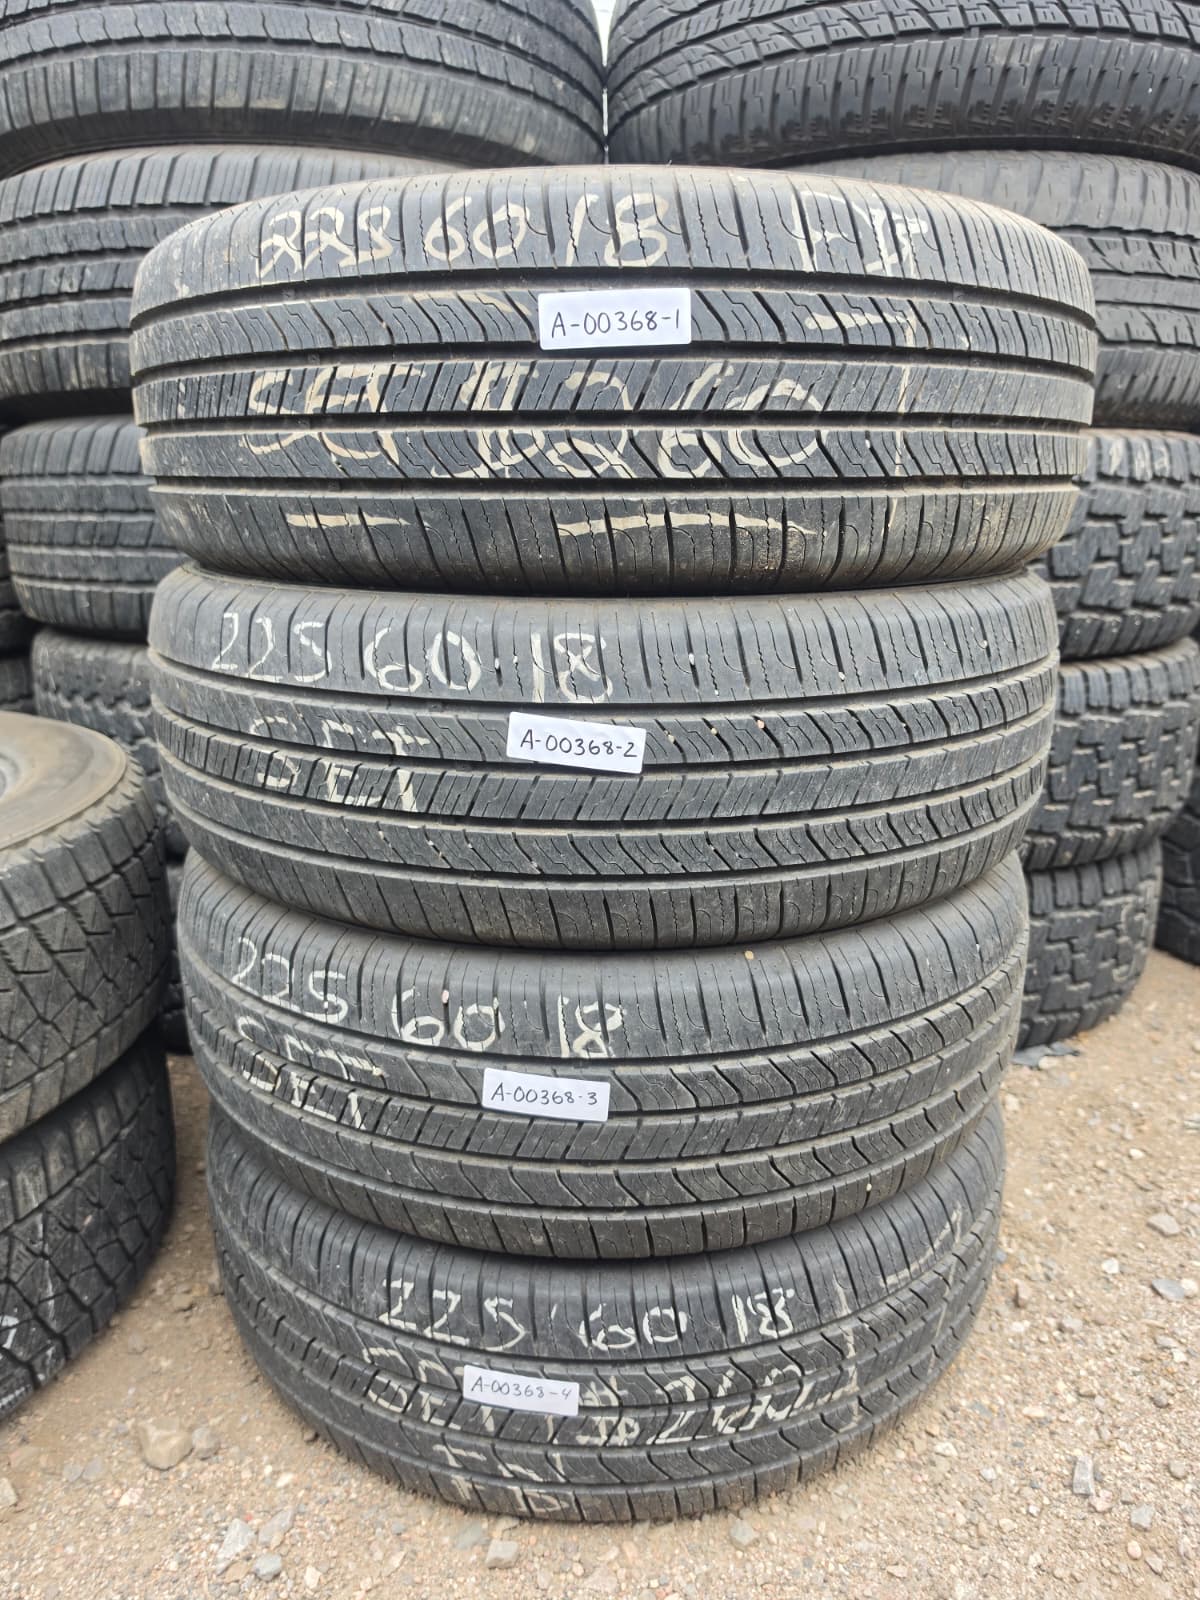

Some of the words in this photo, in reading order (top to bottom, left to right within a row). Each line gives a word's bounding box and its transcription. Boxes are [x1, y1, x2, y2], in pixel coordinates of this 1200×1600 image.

[423, 196, 528, 261] 60
[560, 192, 670, 268] 18
[551, 308, 682, 339] A-00368-1
[212, 612, 332, 684] 225
[363, 627, 482, 692] 60
[530, 631, 613, 702] 18
[519, 728, 638, 760] A-00368-2
[230, 936, 349, 1023] 225
[390, 988, 505, 1051] 60
[557, 995, 628, 1059] 18
[490, 1081, 599, 1108] A-00368-3
[378, 1278, 525, 1351] 225
[578, 1303, 688, 1351] 60
[731, 1287, 796, 1344] 18
[470, 1374, 573, 1400] A-00368-4
